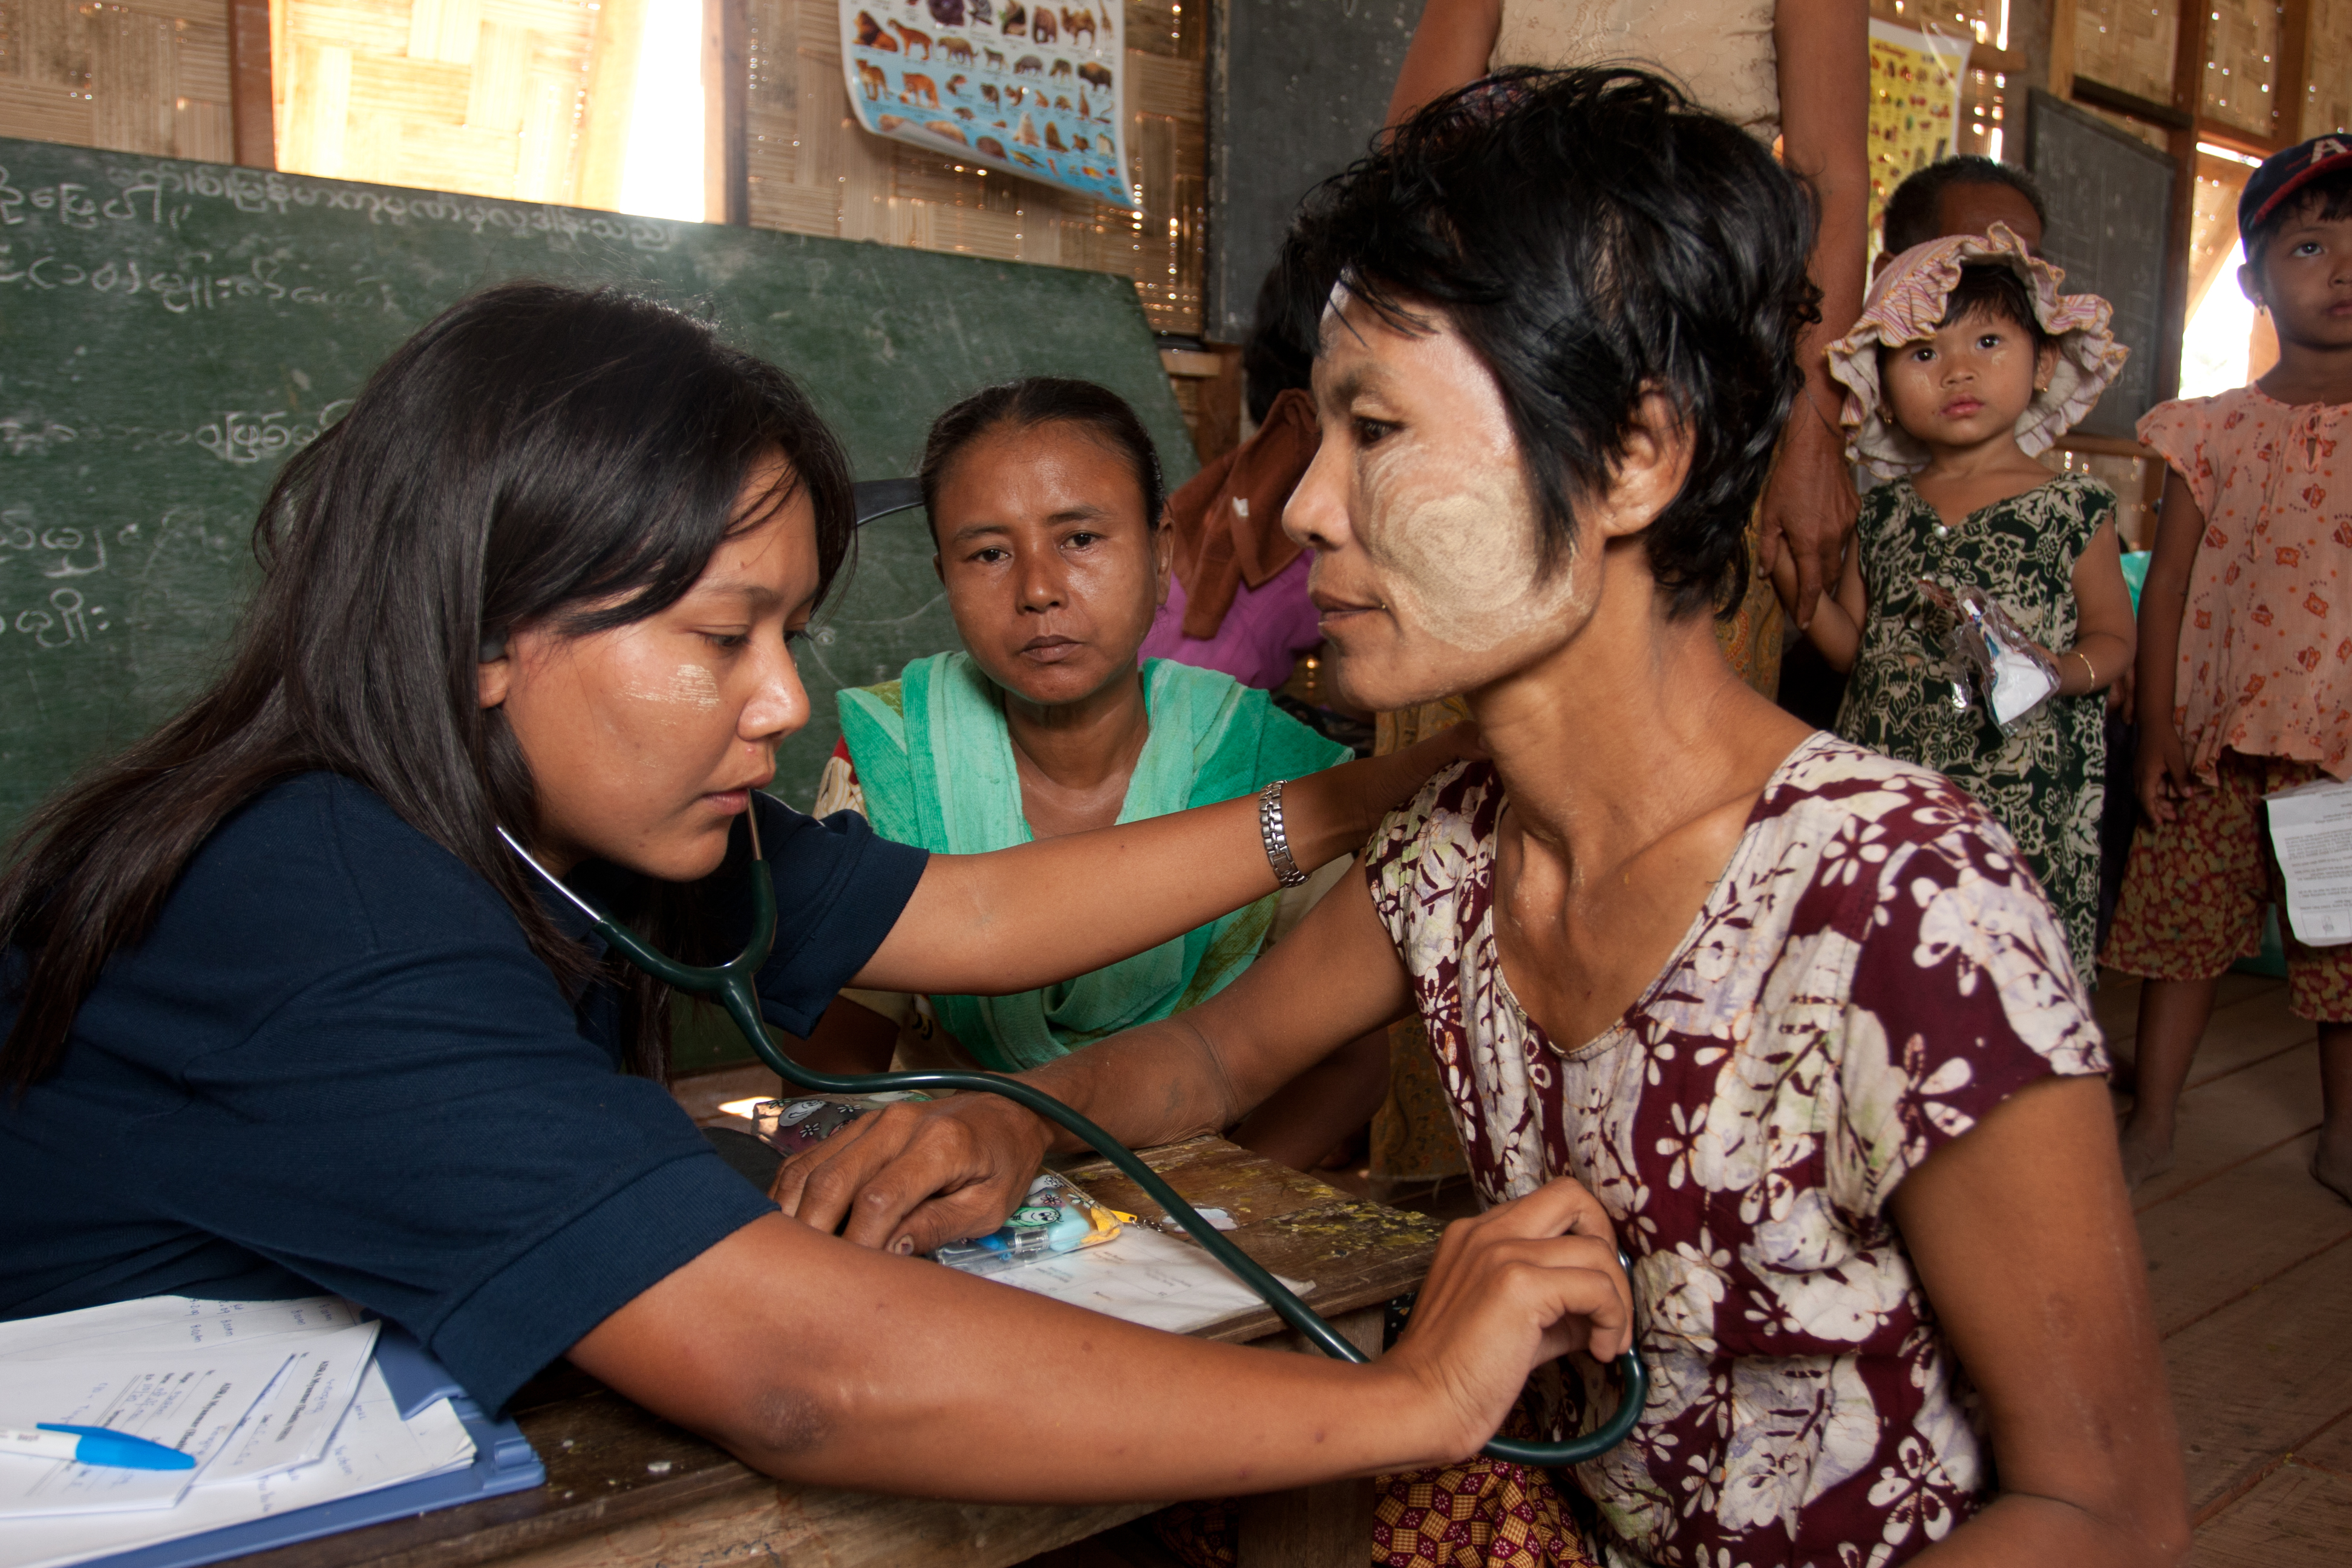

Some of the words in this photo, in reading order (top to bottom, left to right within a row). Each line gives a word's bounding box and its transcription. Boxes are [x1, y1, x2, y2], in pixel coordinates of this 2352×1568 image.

[313, 1360, 330, 1378] ADRA
[212, 1382, 232, 1400] ADRA
[299, 1376, 322, 1404] Myanmar
[191, 1399, 220, 1428] Myanmar
